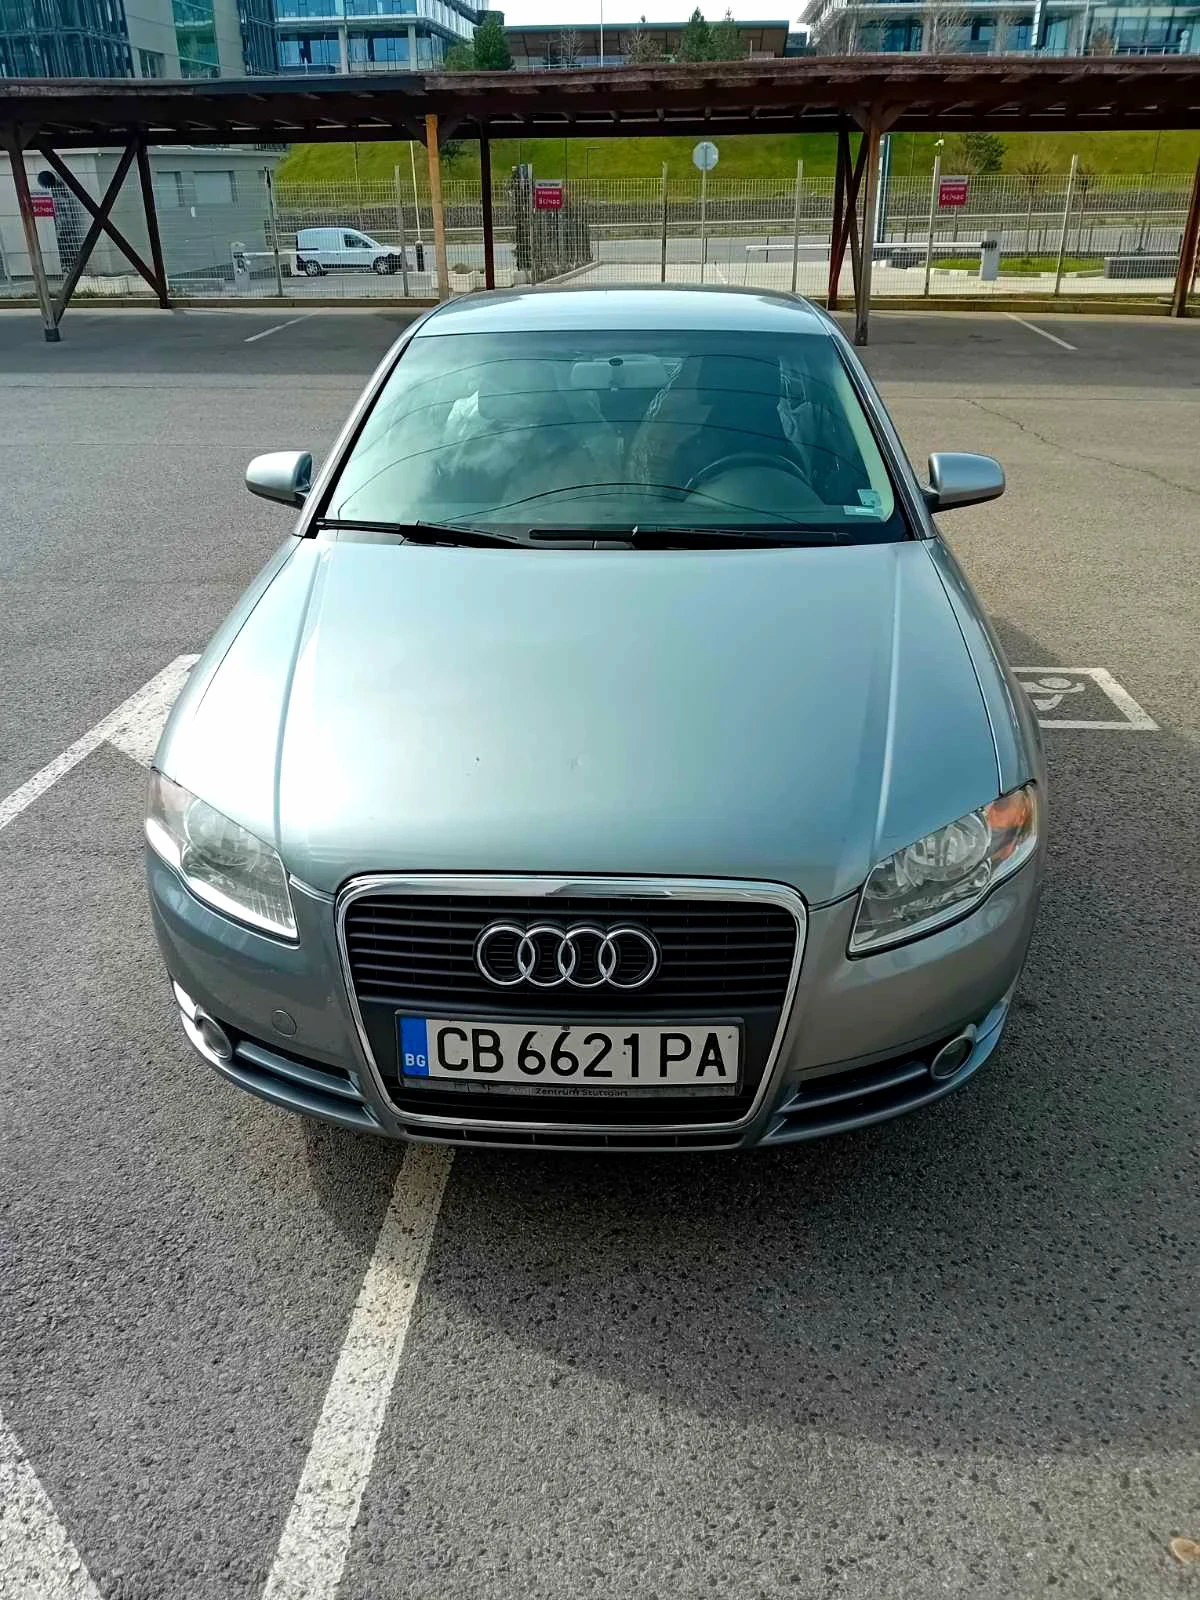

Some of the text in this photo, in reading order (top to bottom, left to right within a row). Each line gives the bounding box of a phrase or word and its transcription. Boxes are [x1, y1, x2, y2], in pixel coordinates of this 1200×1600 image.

[436, 1027, 727, 1078] CB 6621 PA
[404, 1053, 426, 1067] BG
[535, 1087, 579, 1096] Zentrum
